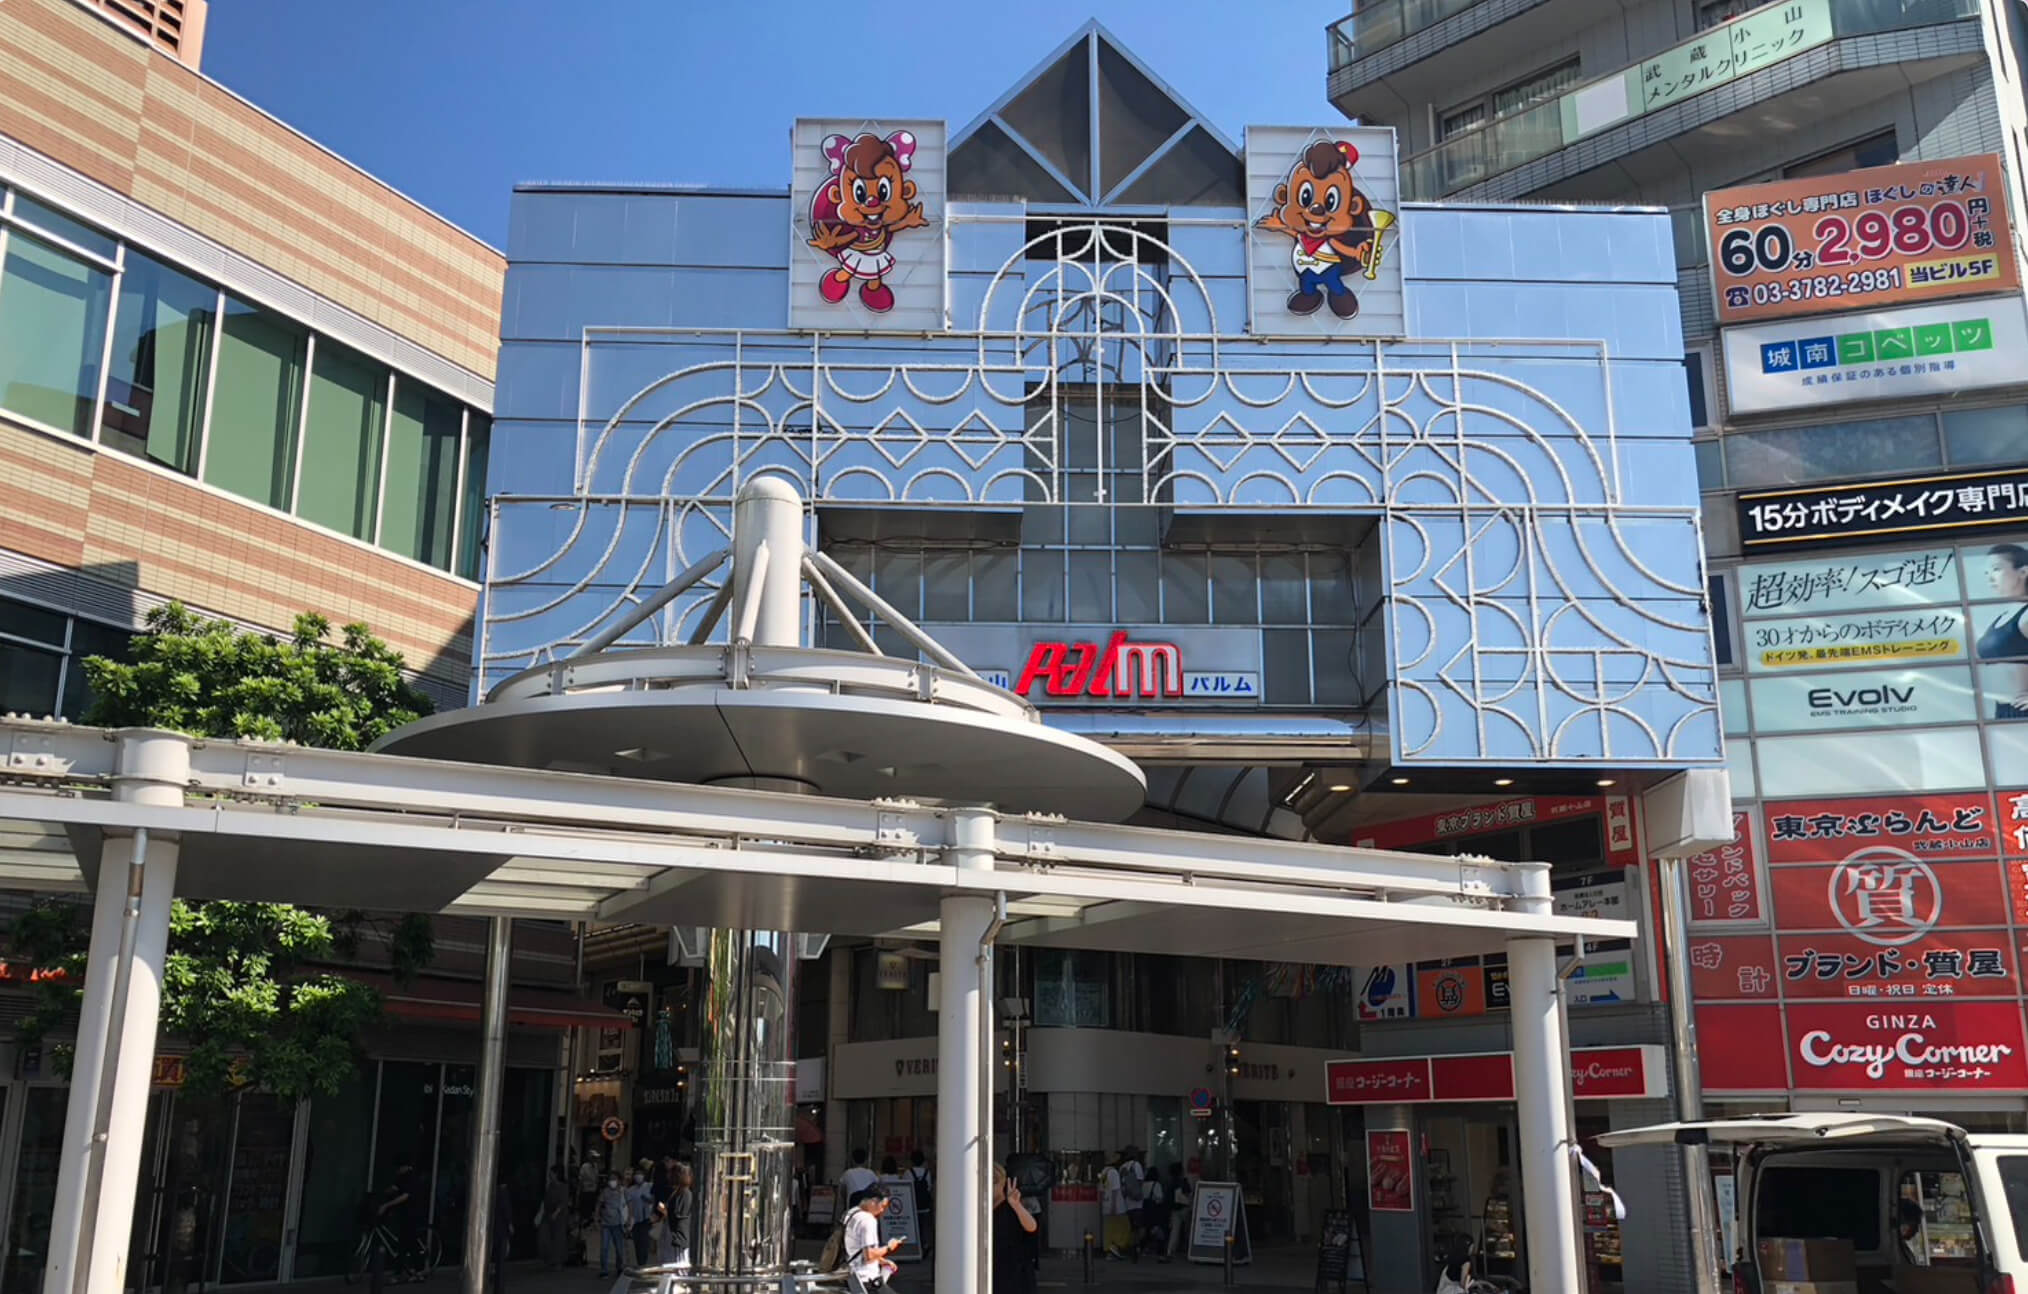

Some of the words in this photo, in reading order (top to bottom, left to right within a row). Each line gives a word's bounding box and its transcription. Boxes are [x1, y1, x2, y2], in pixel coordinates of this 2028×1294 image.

[1645, 6, 1803, 82] 武蔵小山
[1648, 28, 1804, 104] メンタルクリニック
[1716, 191, 1858, 226] 全身ほぐし専門店
[1864, 175, 1977, 204] ほぐしの達人
[1753, 267, 1901, 305] 03-3782-2981
[1909, 258, 1994, 284] 当ビル5F
[1766, 325, 1985, 369] 城南コベッツ
[1801, 360, 1956, 387] 成績保証のある個別指導
[1834, 707, 1879, 716] TRAINING
[1881, 704, 1917, 713] STUDIO
[1845, 863, 1926, 929] 質
[1785, 949, 2006, 980] ブランド・質屋
[1848, 984, 1915, 996] 日曜・祝日
[1922, 983, 1954, 996] 定休
[1866, 1014, 1936, 1029] GINZA
[907, 1058, 938, 1075] VERI
